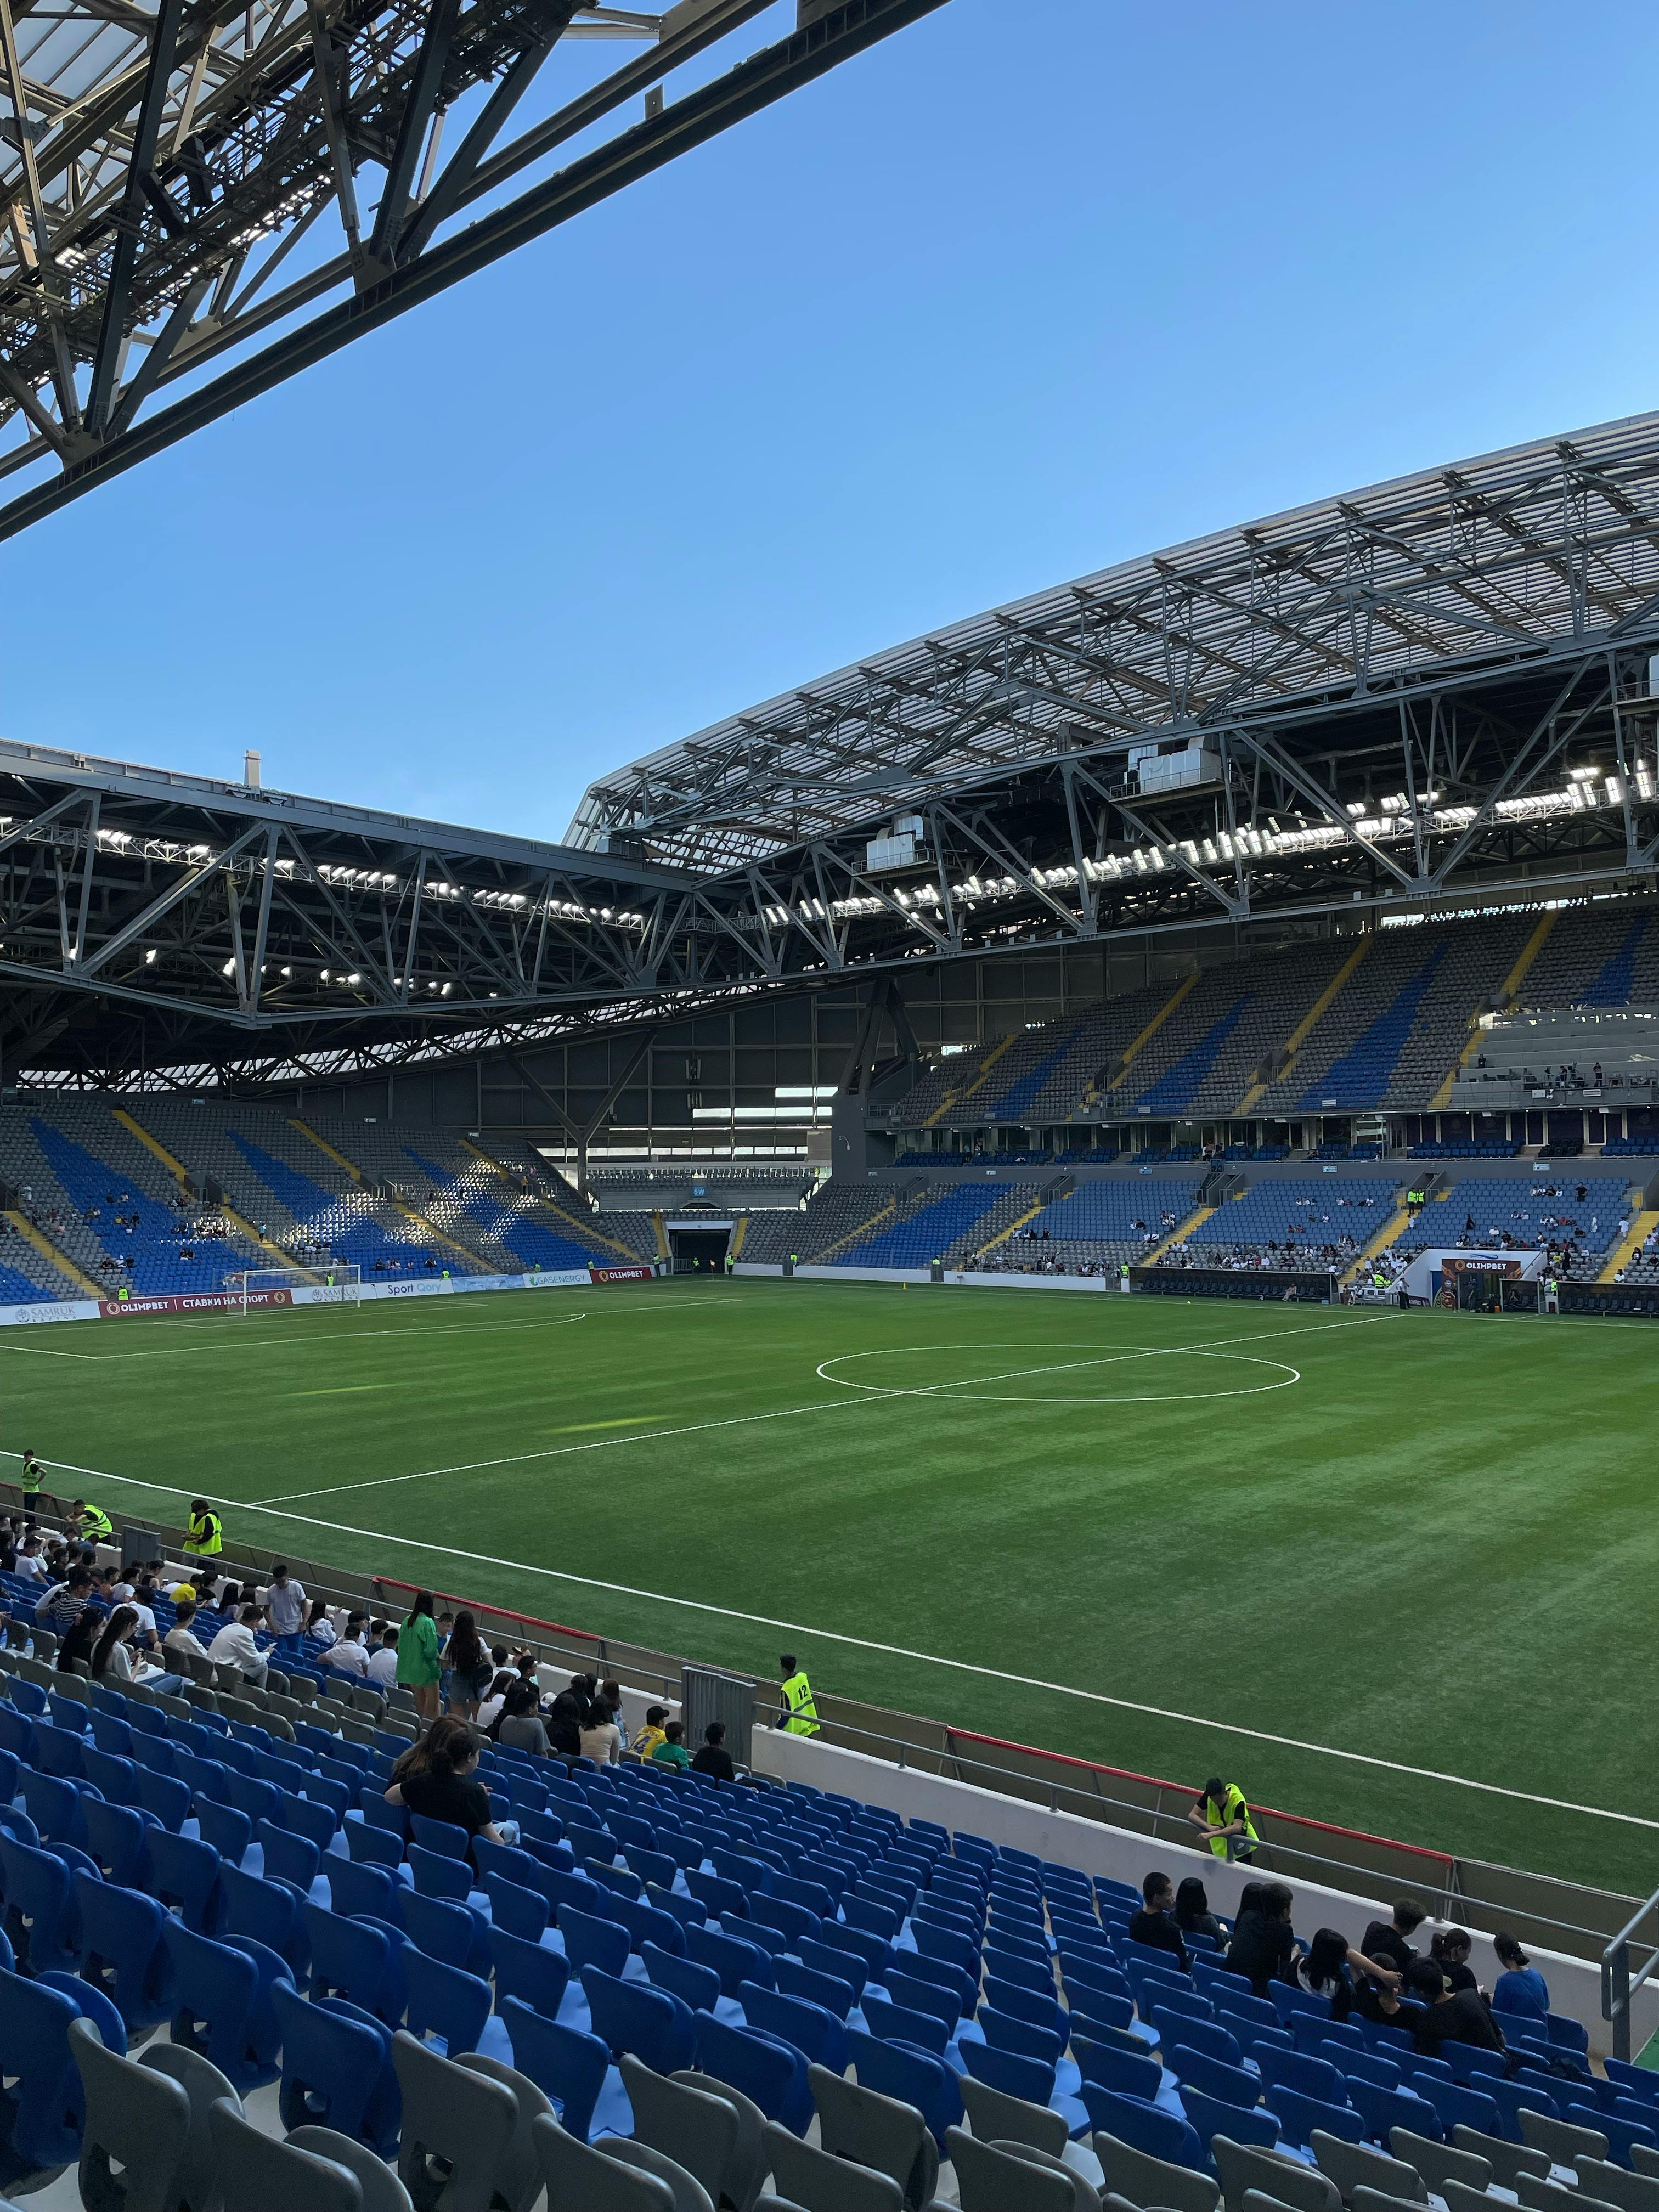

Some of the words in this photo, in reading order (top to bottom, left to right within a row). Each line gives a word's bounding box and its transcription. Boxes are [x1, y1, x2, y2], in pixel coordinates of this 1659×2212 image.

[1466, 1262, 1507, 1270] OLIMPBET
[537, 1274, 585, 1284] GASENERGY
[609, 1270, 644, 1279] OLIMPBET
[388, 1283, 414, 1295] Sport
[416, 1283, 441, 1293] Qory
[183, 1297, 221, 1308] СТАВКИ
[223, 1296, 237, 1305] НА
[239, 1294, 269, 1304] СПОРТ
[121, 1301, 168, 1312] OLIMPBET
[31, 1307, 75, 1317] SAMRUK
[798, 1685, 808, 1700] 12
